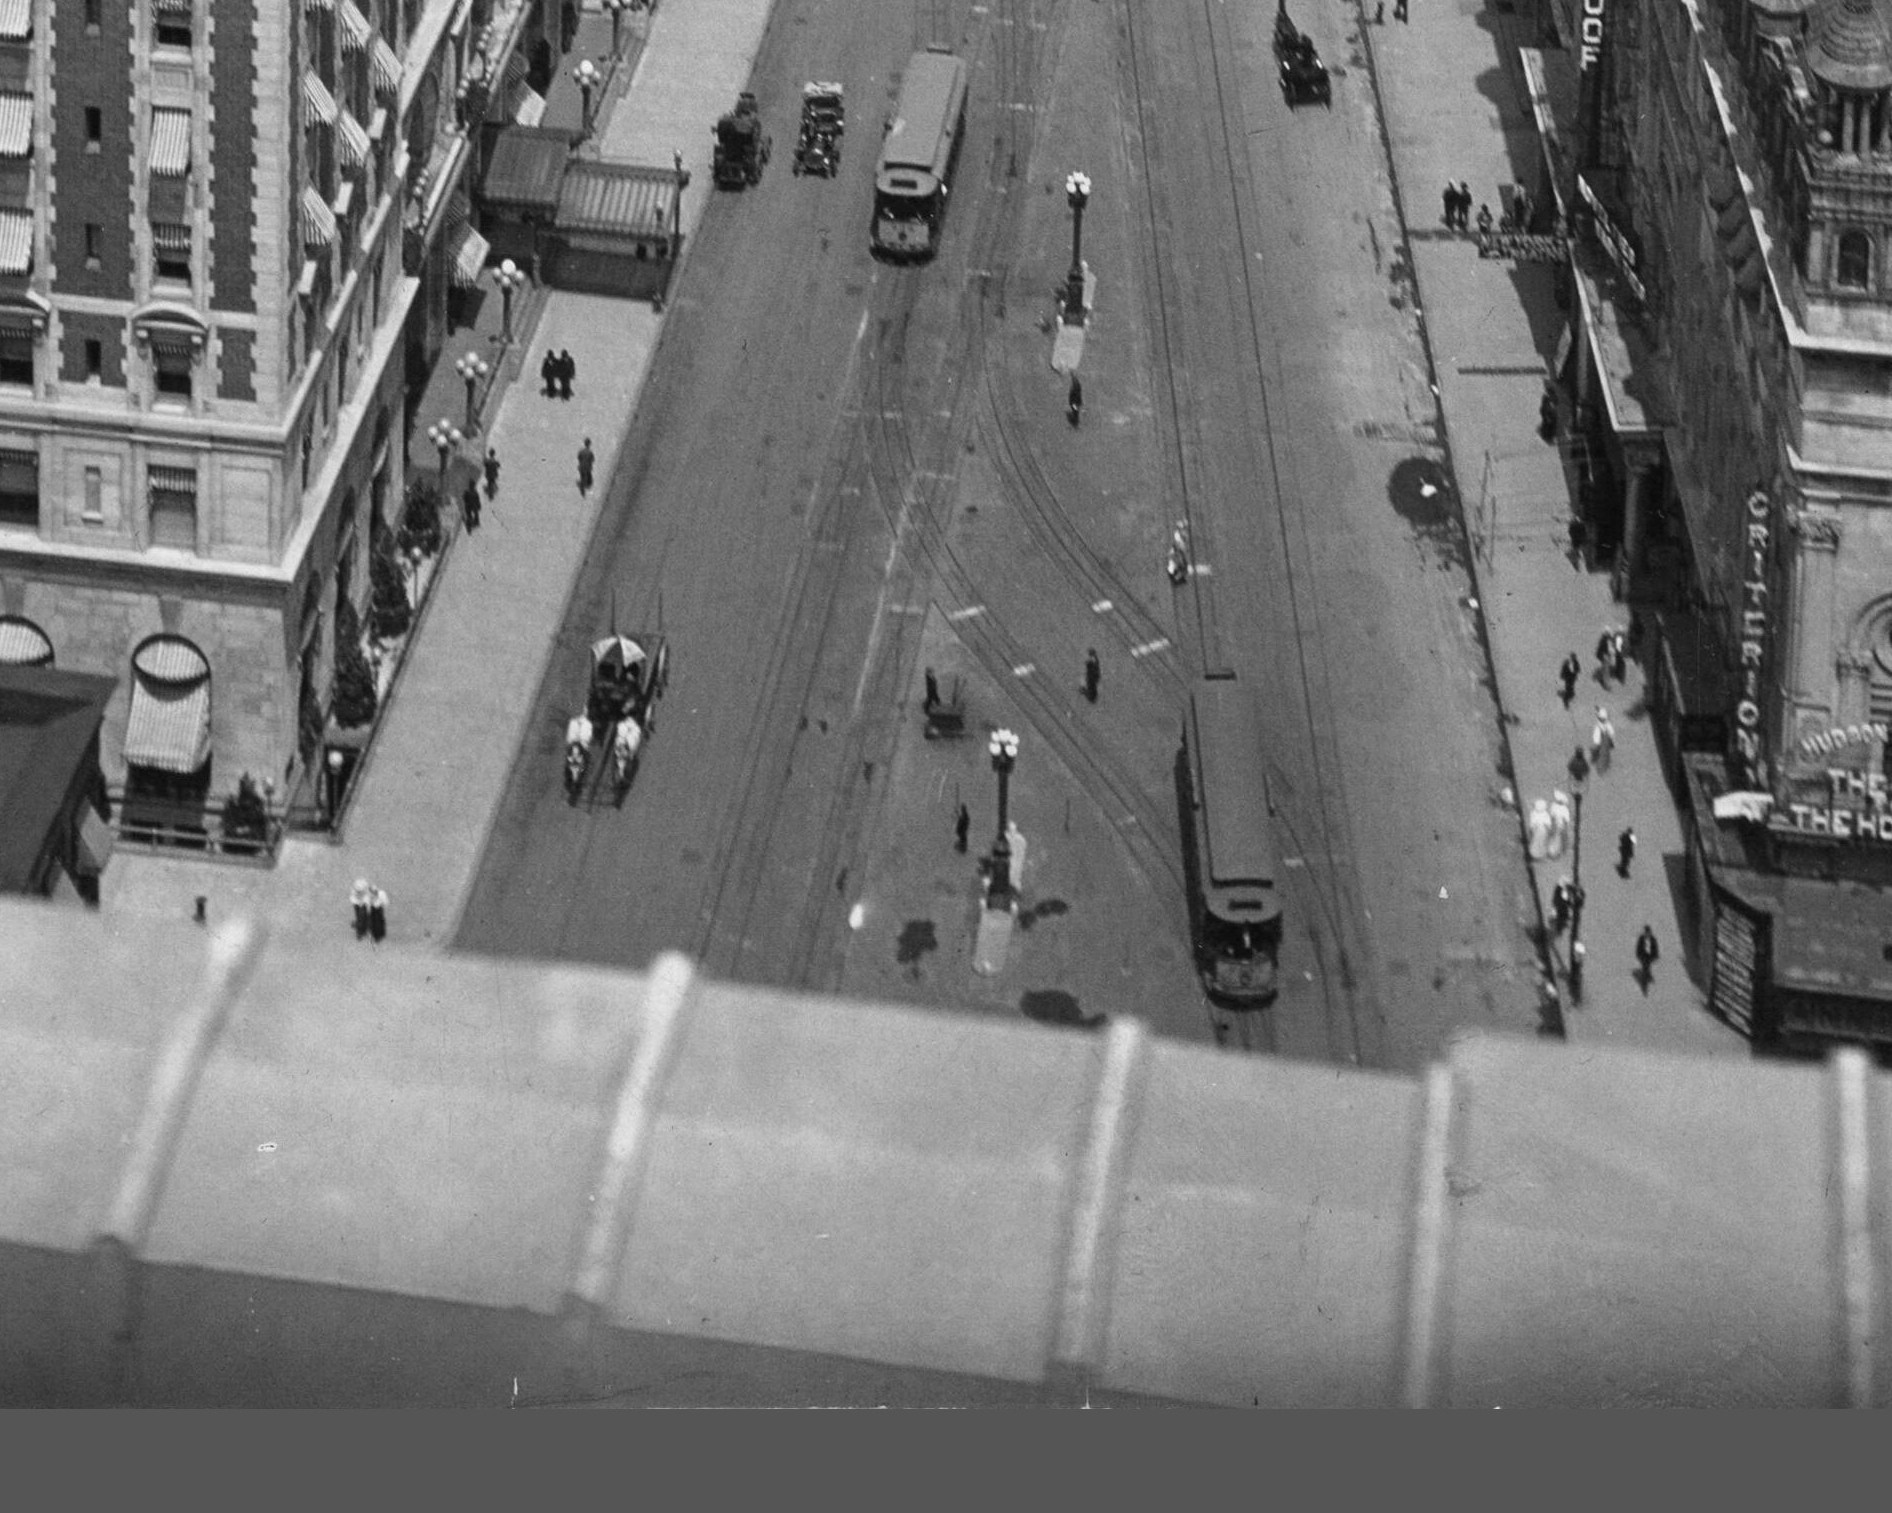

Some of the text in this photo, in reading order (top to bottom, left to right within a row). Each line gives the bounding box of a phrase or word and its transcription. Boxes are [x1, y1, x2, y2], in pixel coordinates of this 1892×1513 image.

[1737, 490, 1769, 761] CRITERION
[1801, 723, 1888, 755] HUDSON
[1790, 803, 1852, 836] THE
